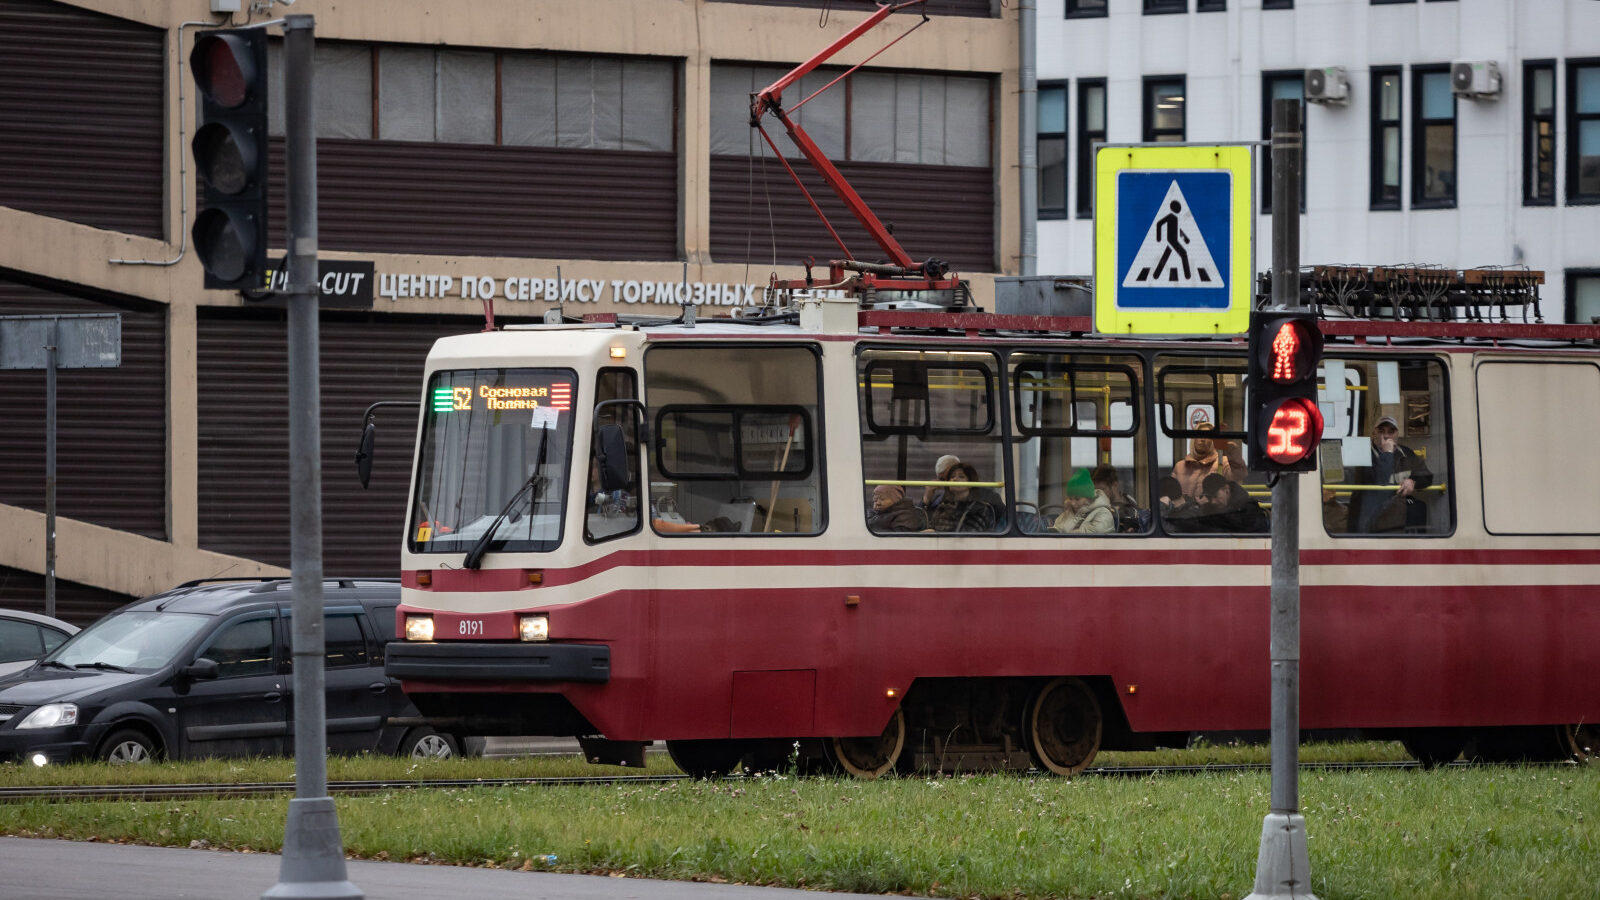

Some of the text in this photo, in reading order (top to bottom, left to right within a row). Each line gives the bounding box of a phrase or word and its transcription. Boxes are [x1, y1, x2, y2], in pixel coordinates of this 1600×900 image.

[380, 273, 453, 301] ЦЕНТР
[461, 275, 496, 300] ПО
[504, 277, 605, 302] СЕРВИСУ
[611, 279, 756, 306] ТОРМОЗНЫХ
[453, 387, 472, 410] 52
[479, 385, 548, 397] Сосновая
[487, 397, 538, 409] Поляна
[1268, 410, 1306, 454] 52
[459, 620, 484, 635] 8191
